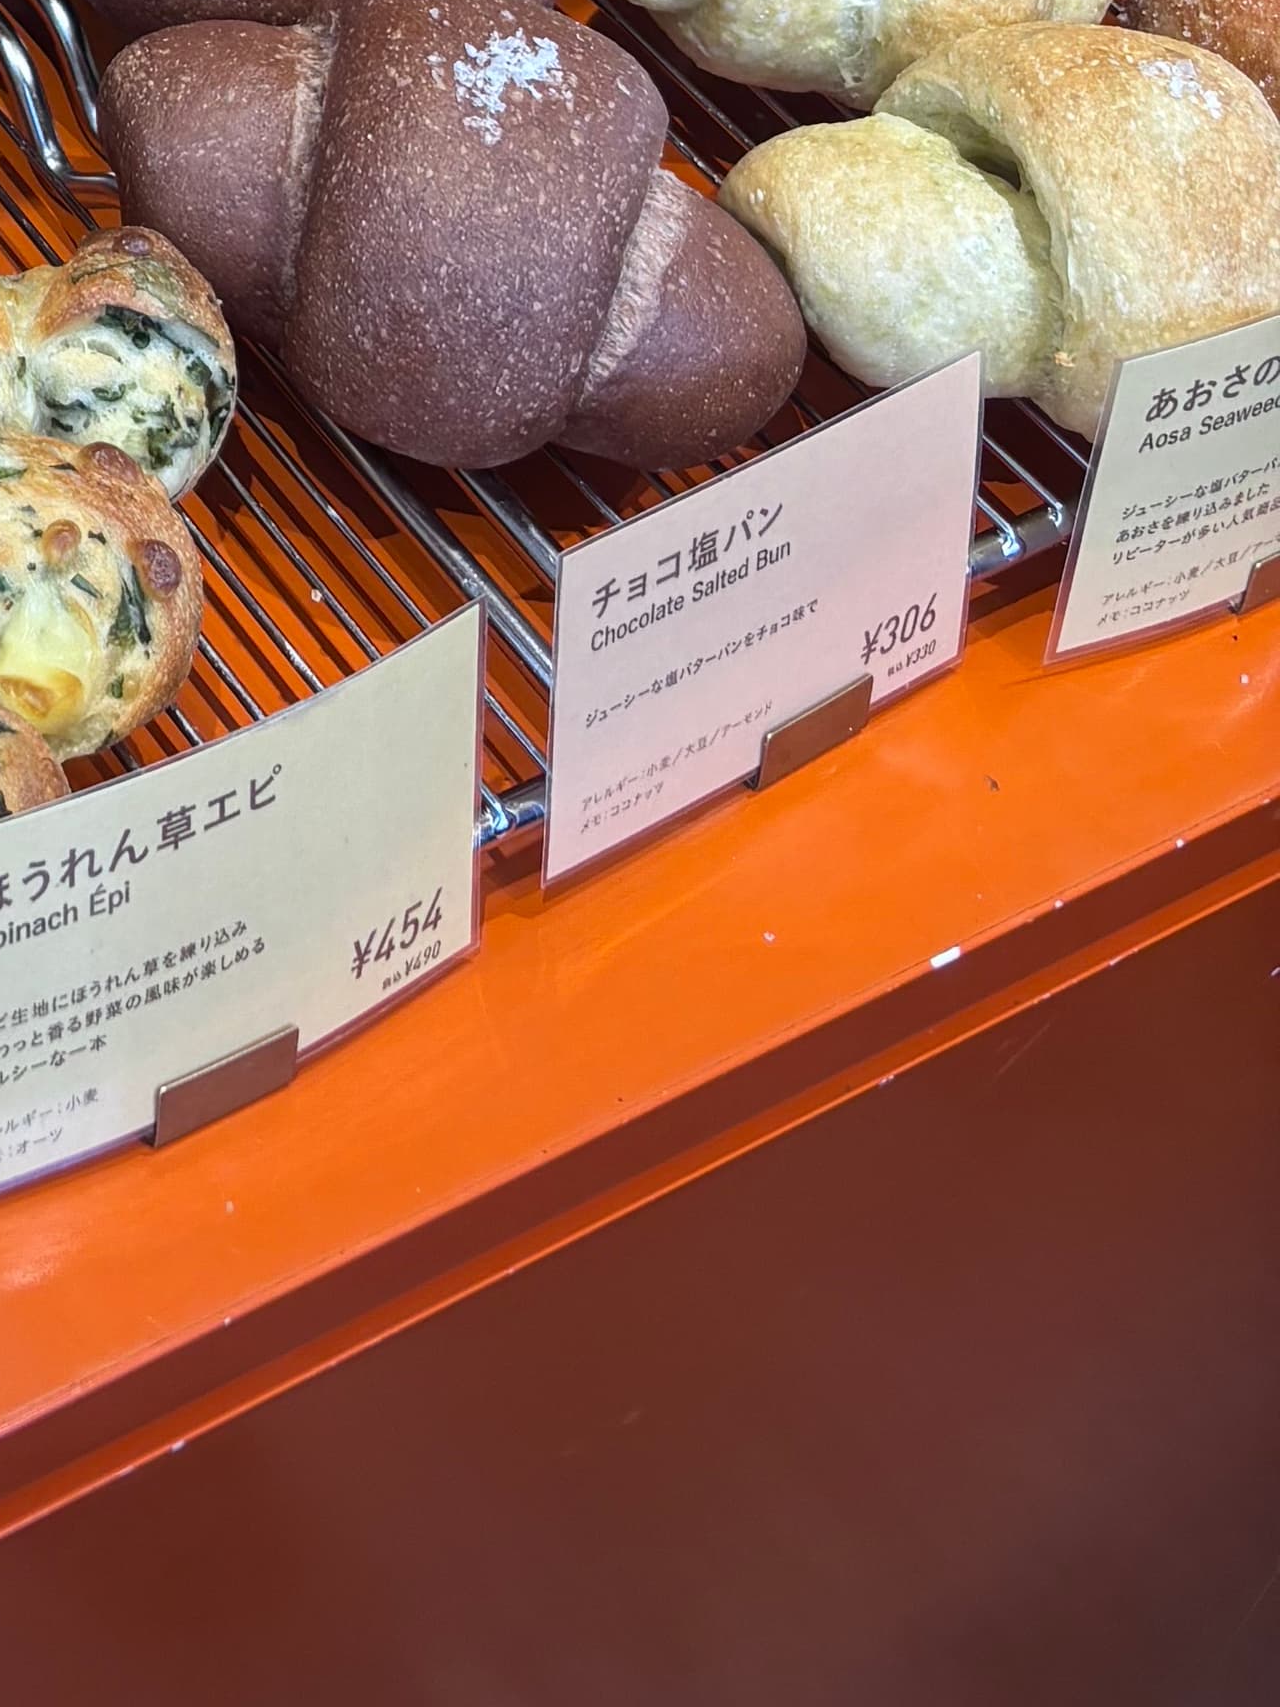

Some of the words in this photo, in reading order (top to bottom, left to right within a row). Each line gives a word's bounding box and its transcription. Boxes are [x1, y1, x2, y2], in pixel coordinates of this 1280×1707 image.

[1145, 355, 1280, 421] あおさの
[1139, 427, 1191, 453] Aosa
[1116, 483, 1270, 543] あおさを練り込みました
[591, 502, 783, 619] チョコ塩パン
[591, 593, 685, 653] Chocolate
[691, 558, 750, 603] Salted
[756, 541, 791, 572] Bun
[860, 593, 938, 665] ¥306
[89, 881, 133, 922] Épi
[351, 886, 443, 979] ¥454
